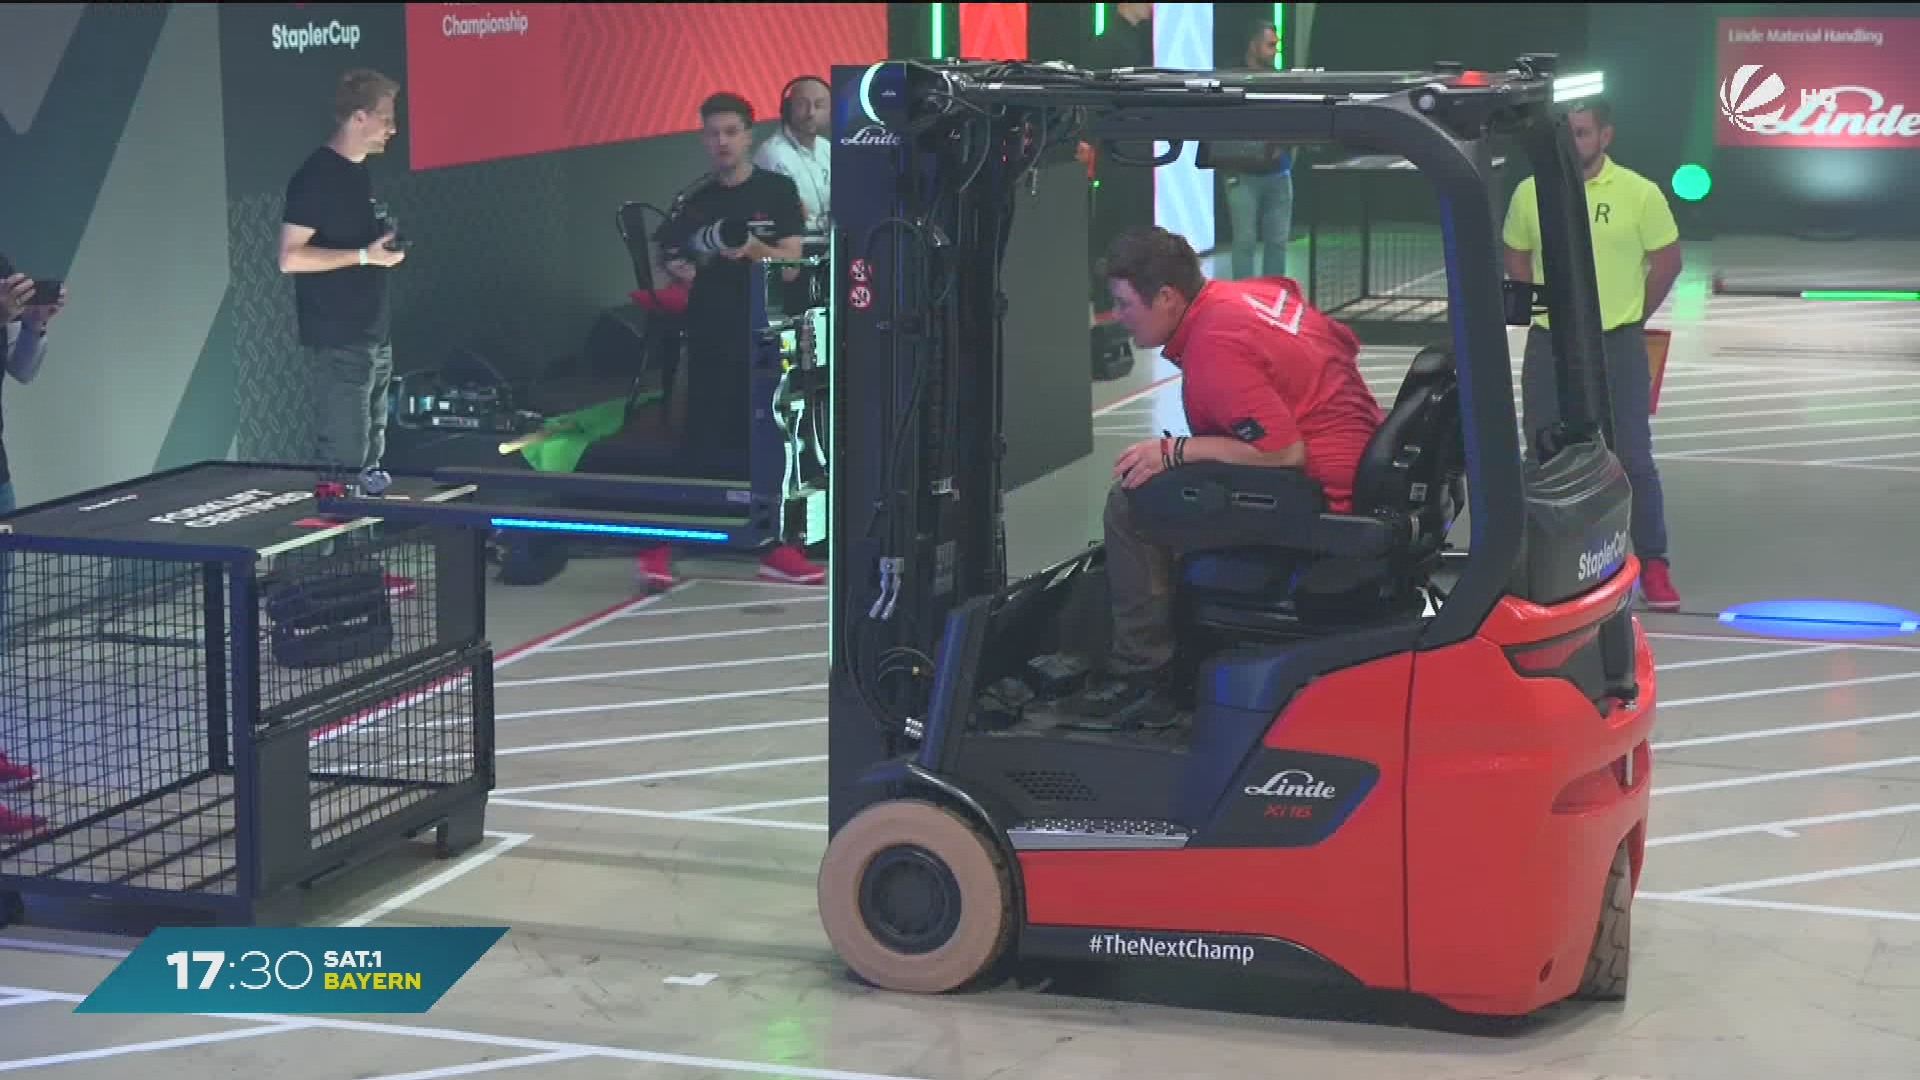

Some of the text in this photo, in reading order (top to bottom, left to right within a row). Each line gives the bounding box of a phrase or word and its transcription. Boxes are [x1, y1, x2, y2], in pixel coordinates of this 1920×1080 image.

[271, 20, 361, 53] StaplerCup
[442, 11, 529, 39] Championship
[1728, 28, 1884, 46] Linde Material Handling
[1755, 85, 1920, 136] Linde
[1595, 203, 1611, 224] R
[1244, 769, 1336, 799] Linde
[1089, 933, 1255, 966] #TheNextChamp
